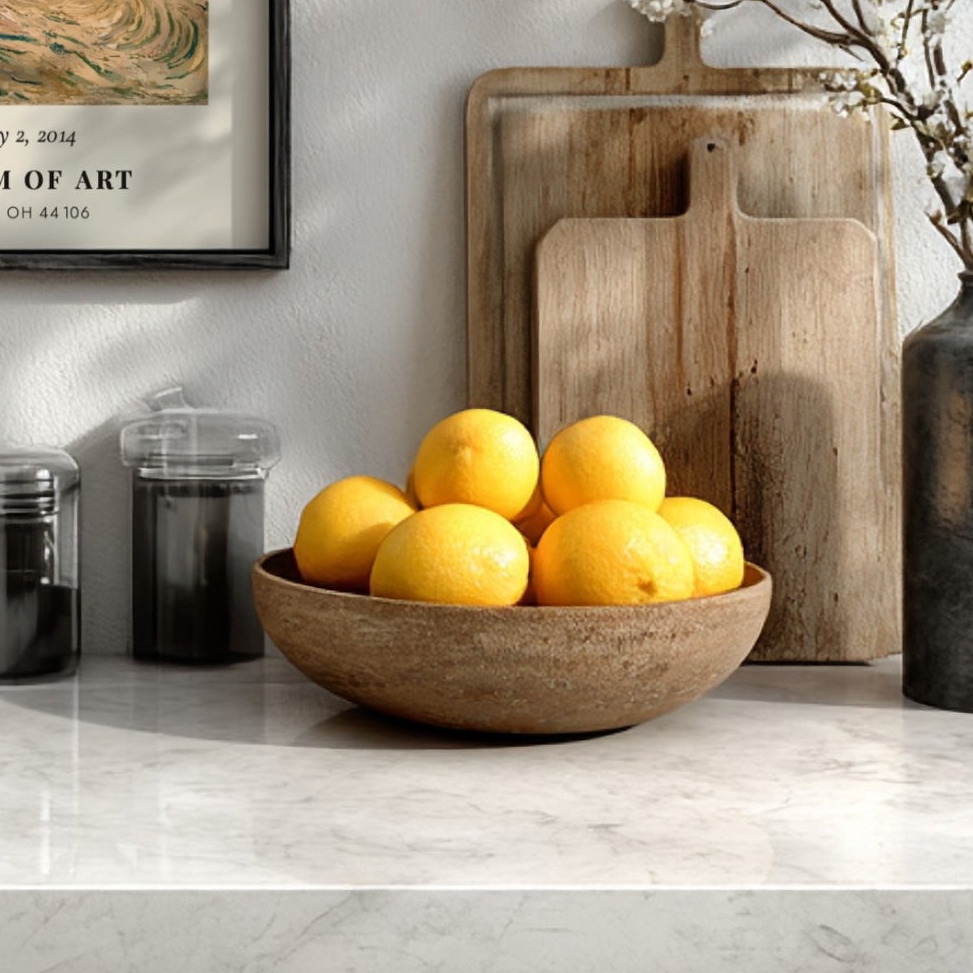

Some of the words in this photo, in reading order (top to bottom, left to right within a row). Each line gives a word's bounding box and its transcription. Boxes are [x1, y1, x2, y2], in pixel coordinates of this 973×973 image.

[14, 129, 30, 148] 2,
[36, 130, 77, 148] 2014
[23, 169, 63, 192] OF
[74, 169, 133, 191] ART
[6, 205, 33, 220] OH
[38, 204, 90, 220] 44106
